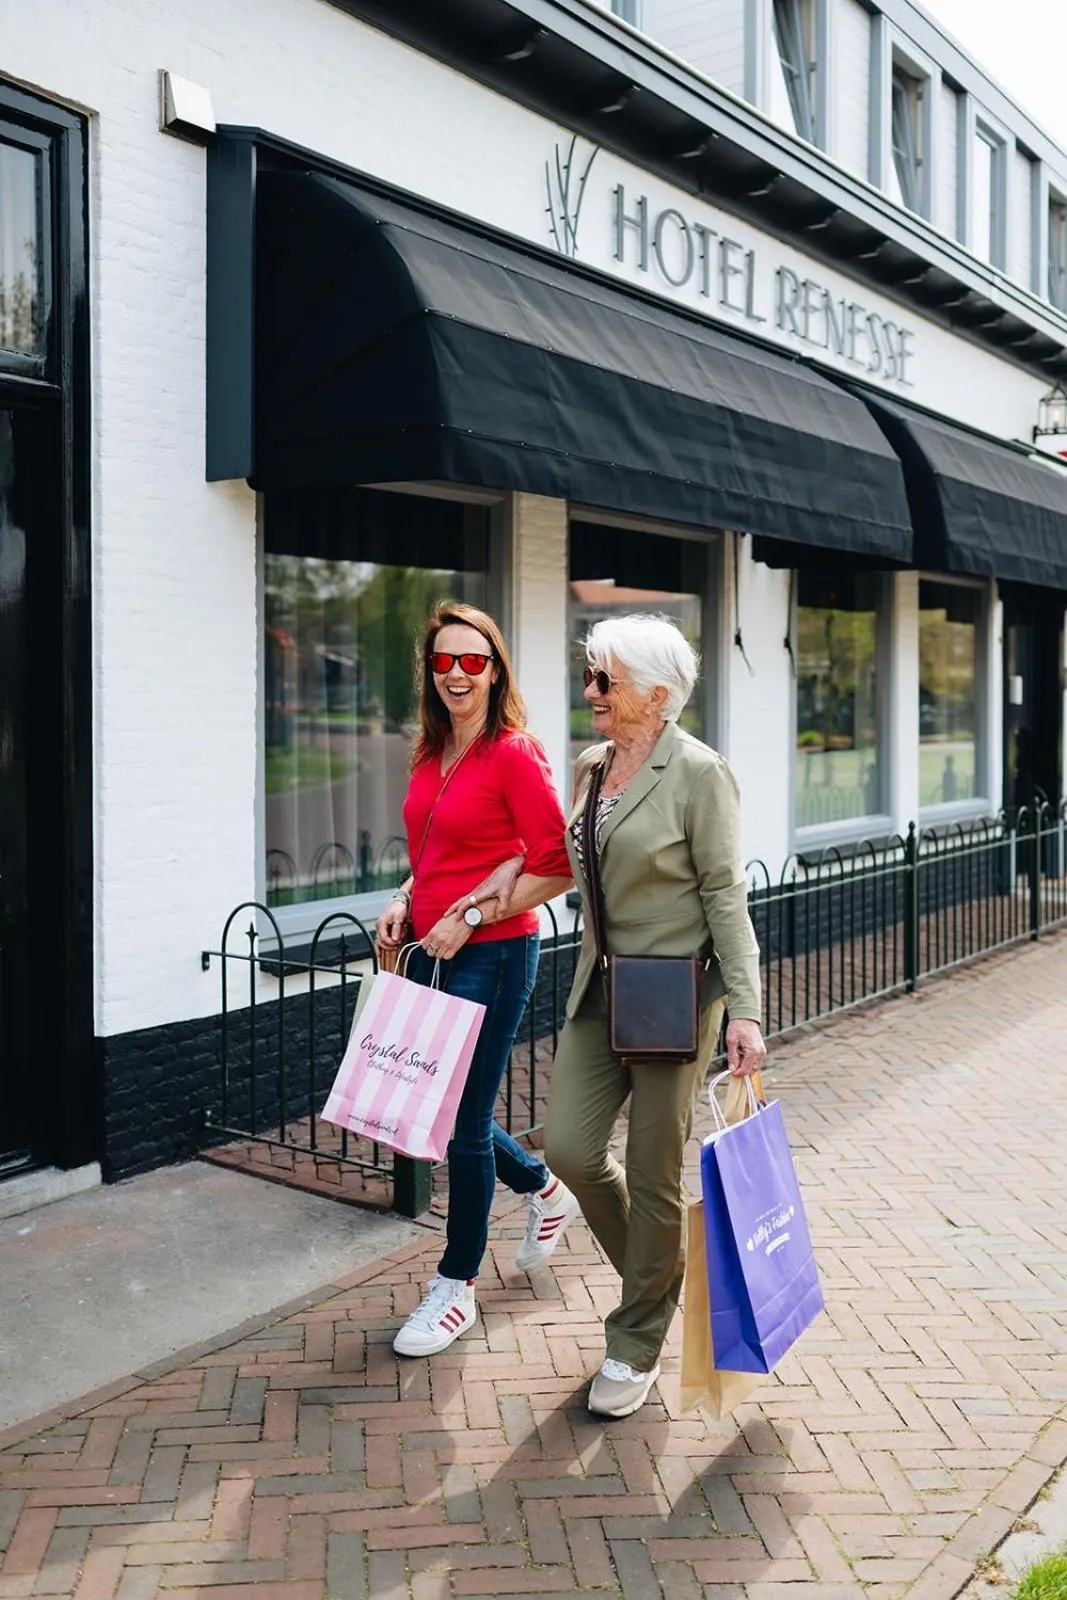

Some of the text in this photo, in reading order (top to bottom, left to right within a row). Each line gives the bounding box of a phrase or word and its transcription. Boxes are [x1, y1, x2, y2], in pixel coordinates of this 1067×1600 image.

[612, 183, 915, 387] HOTEL RENESSE
[360, 1033, 440, 1077] Crystal Sands
